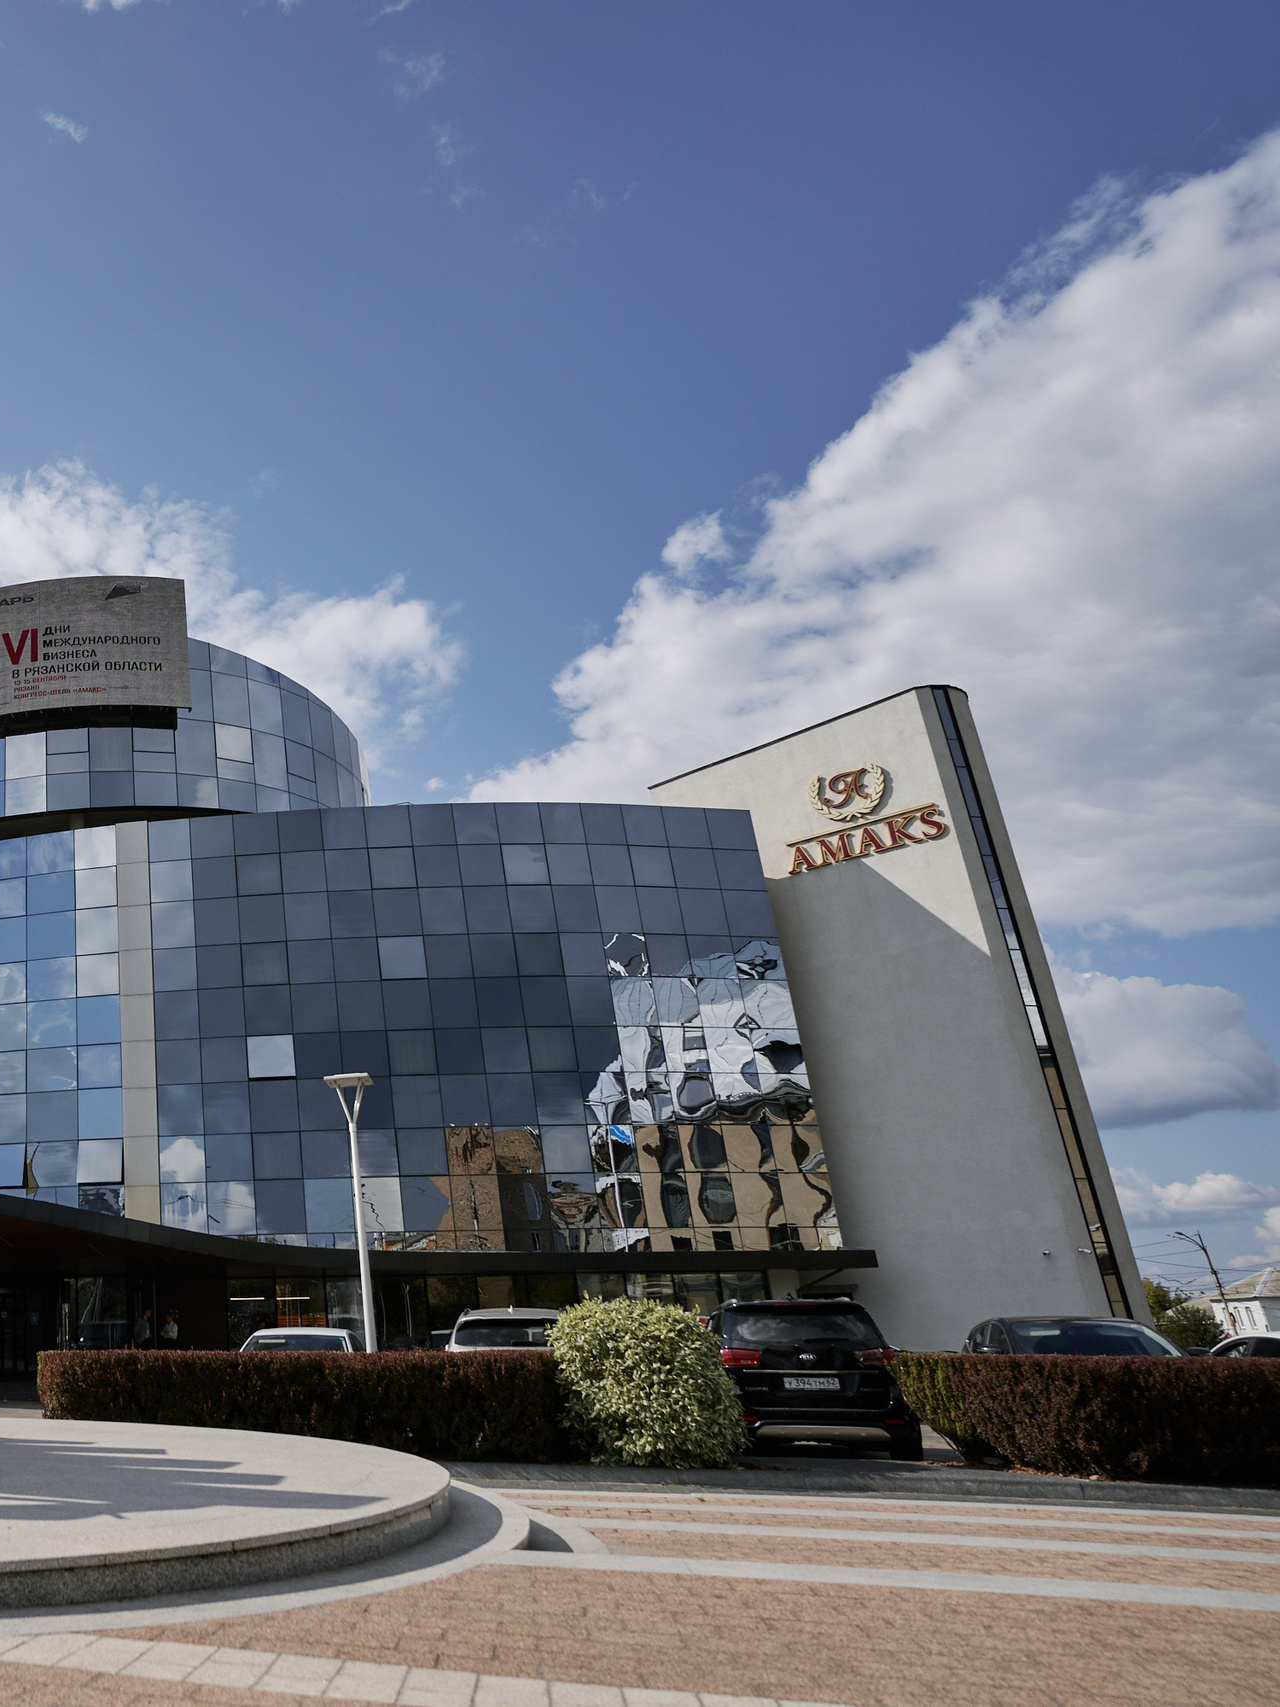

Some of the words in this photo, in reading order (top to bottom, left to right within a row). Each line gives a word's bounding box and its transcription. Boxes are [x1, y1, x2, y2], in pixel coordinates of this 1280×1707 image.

[42, 624, 71, 637] ДНИ
[1, 627, 39, 665] VI
[42, 635, 161, 648] МЕЖДУНАРОДНОГО
[42, 648, 98, 662] БИЗНЕСА
[11, 669, 20, 679] В
[24, 660, 100, 677] РЯЗАНСКОЙ
[104, 661, 162, 672] ОБЛАСТИ
[13, 684, 40, 693] РЯЗАНЬ
[13, 688, 71, 700] КОНГРЕСС-ОТЕЛЬ
[789, 808, 946, 875] AMAKS
